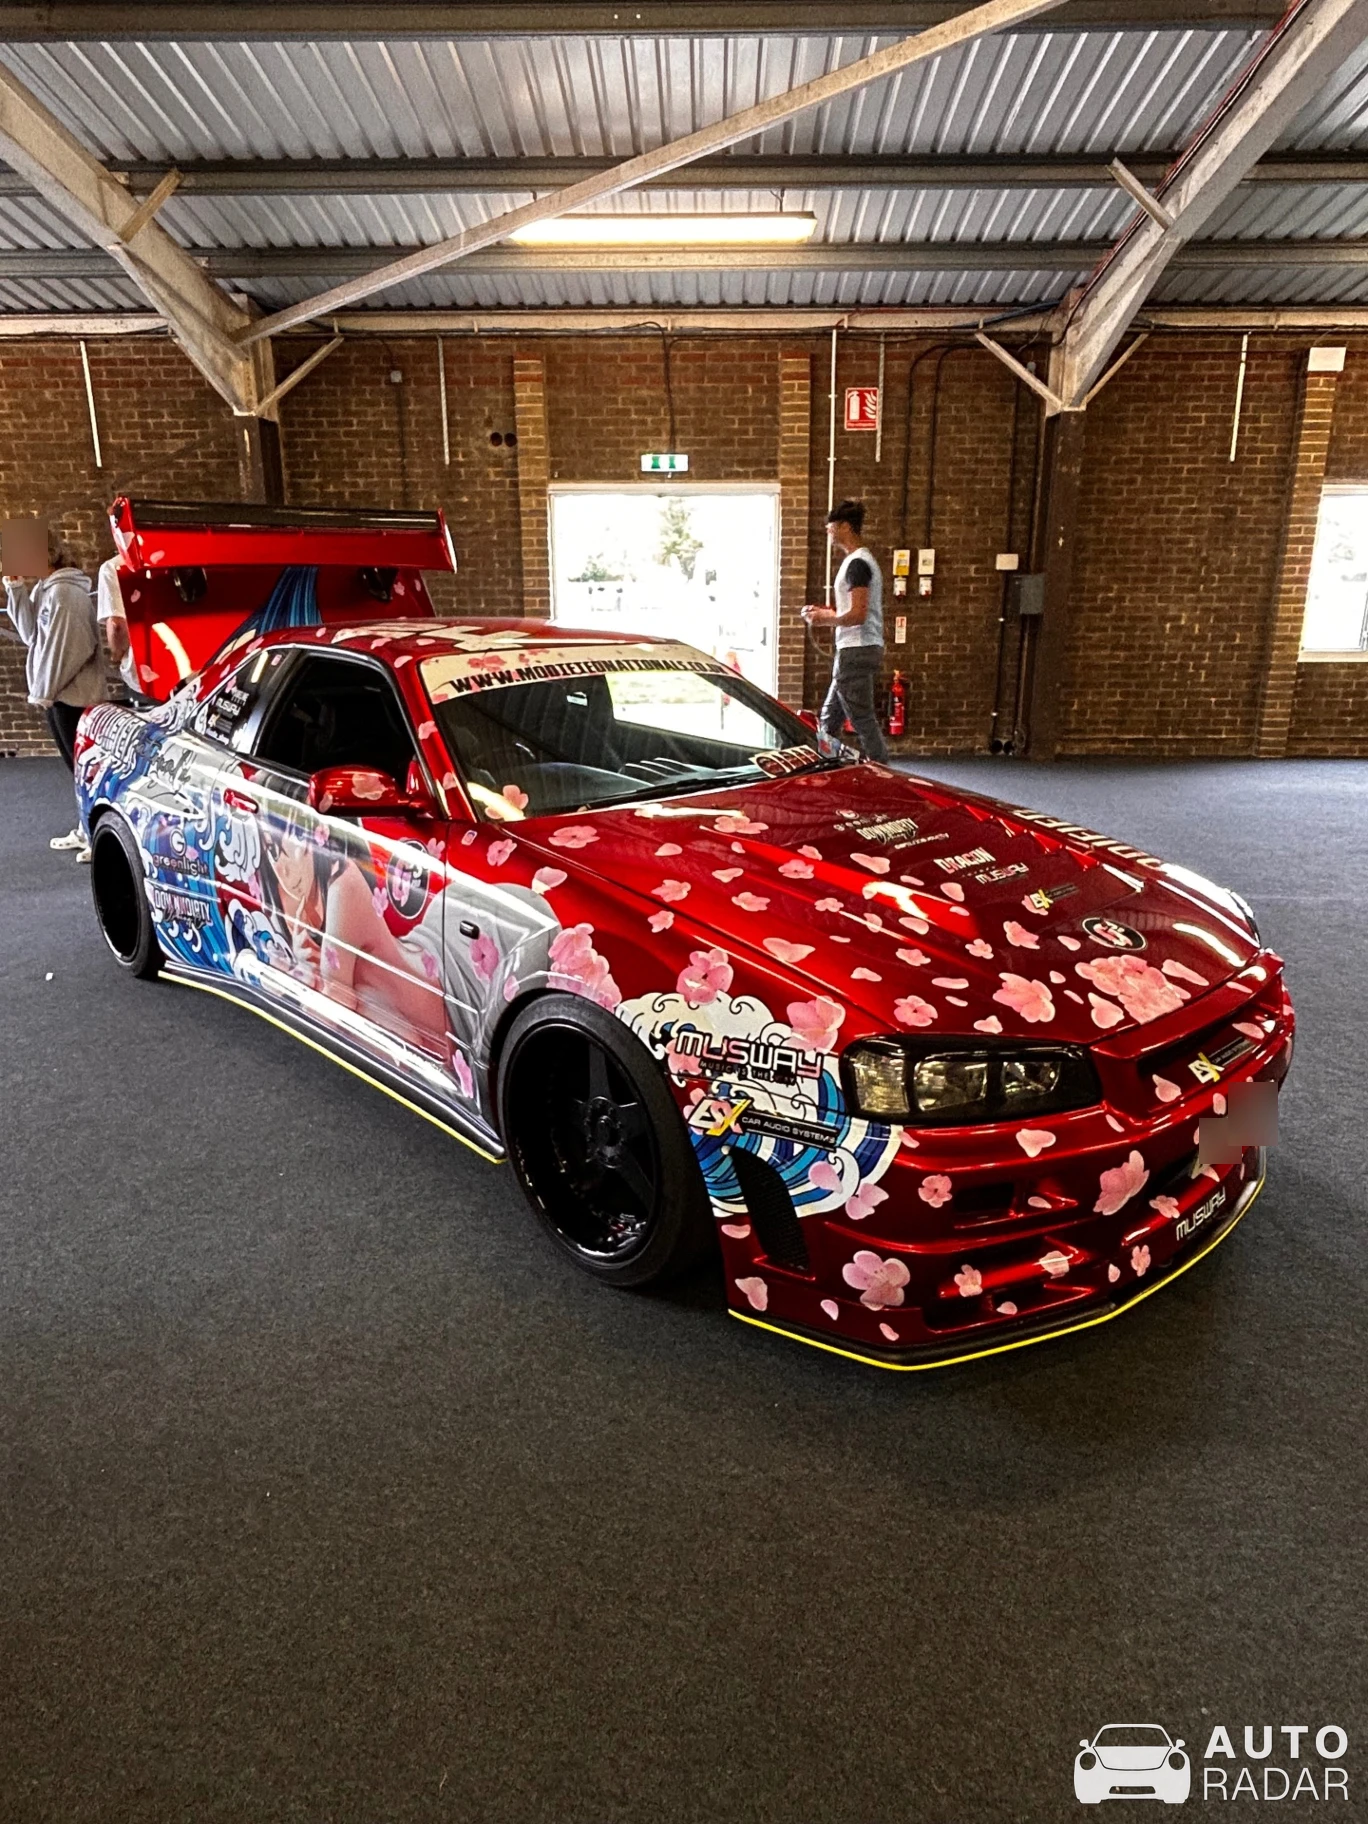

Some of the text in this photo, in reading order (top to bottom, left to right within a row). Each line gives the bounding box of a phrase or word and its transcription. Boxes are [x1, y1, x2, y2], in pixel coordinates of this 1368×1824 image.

[675, 1031, 823, 1078] MUSWAY
[741, 1117, 761, 1125] CAR
[792, 1127, 836, 1144] SYSTEMS
